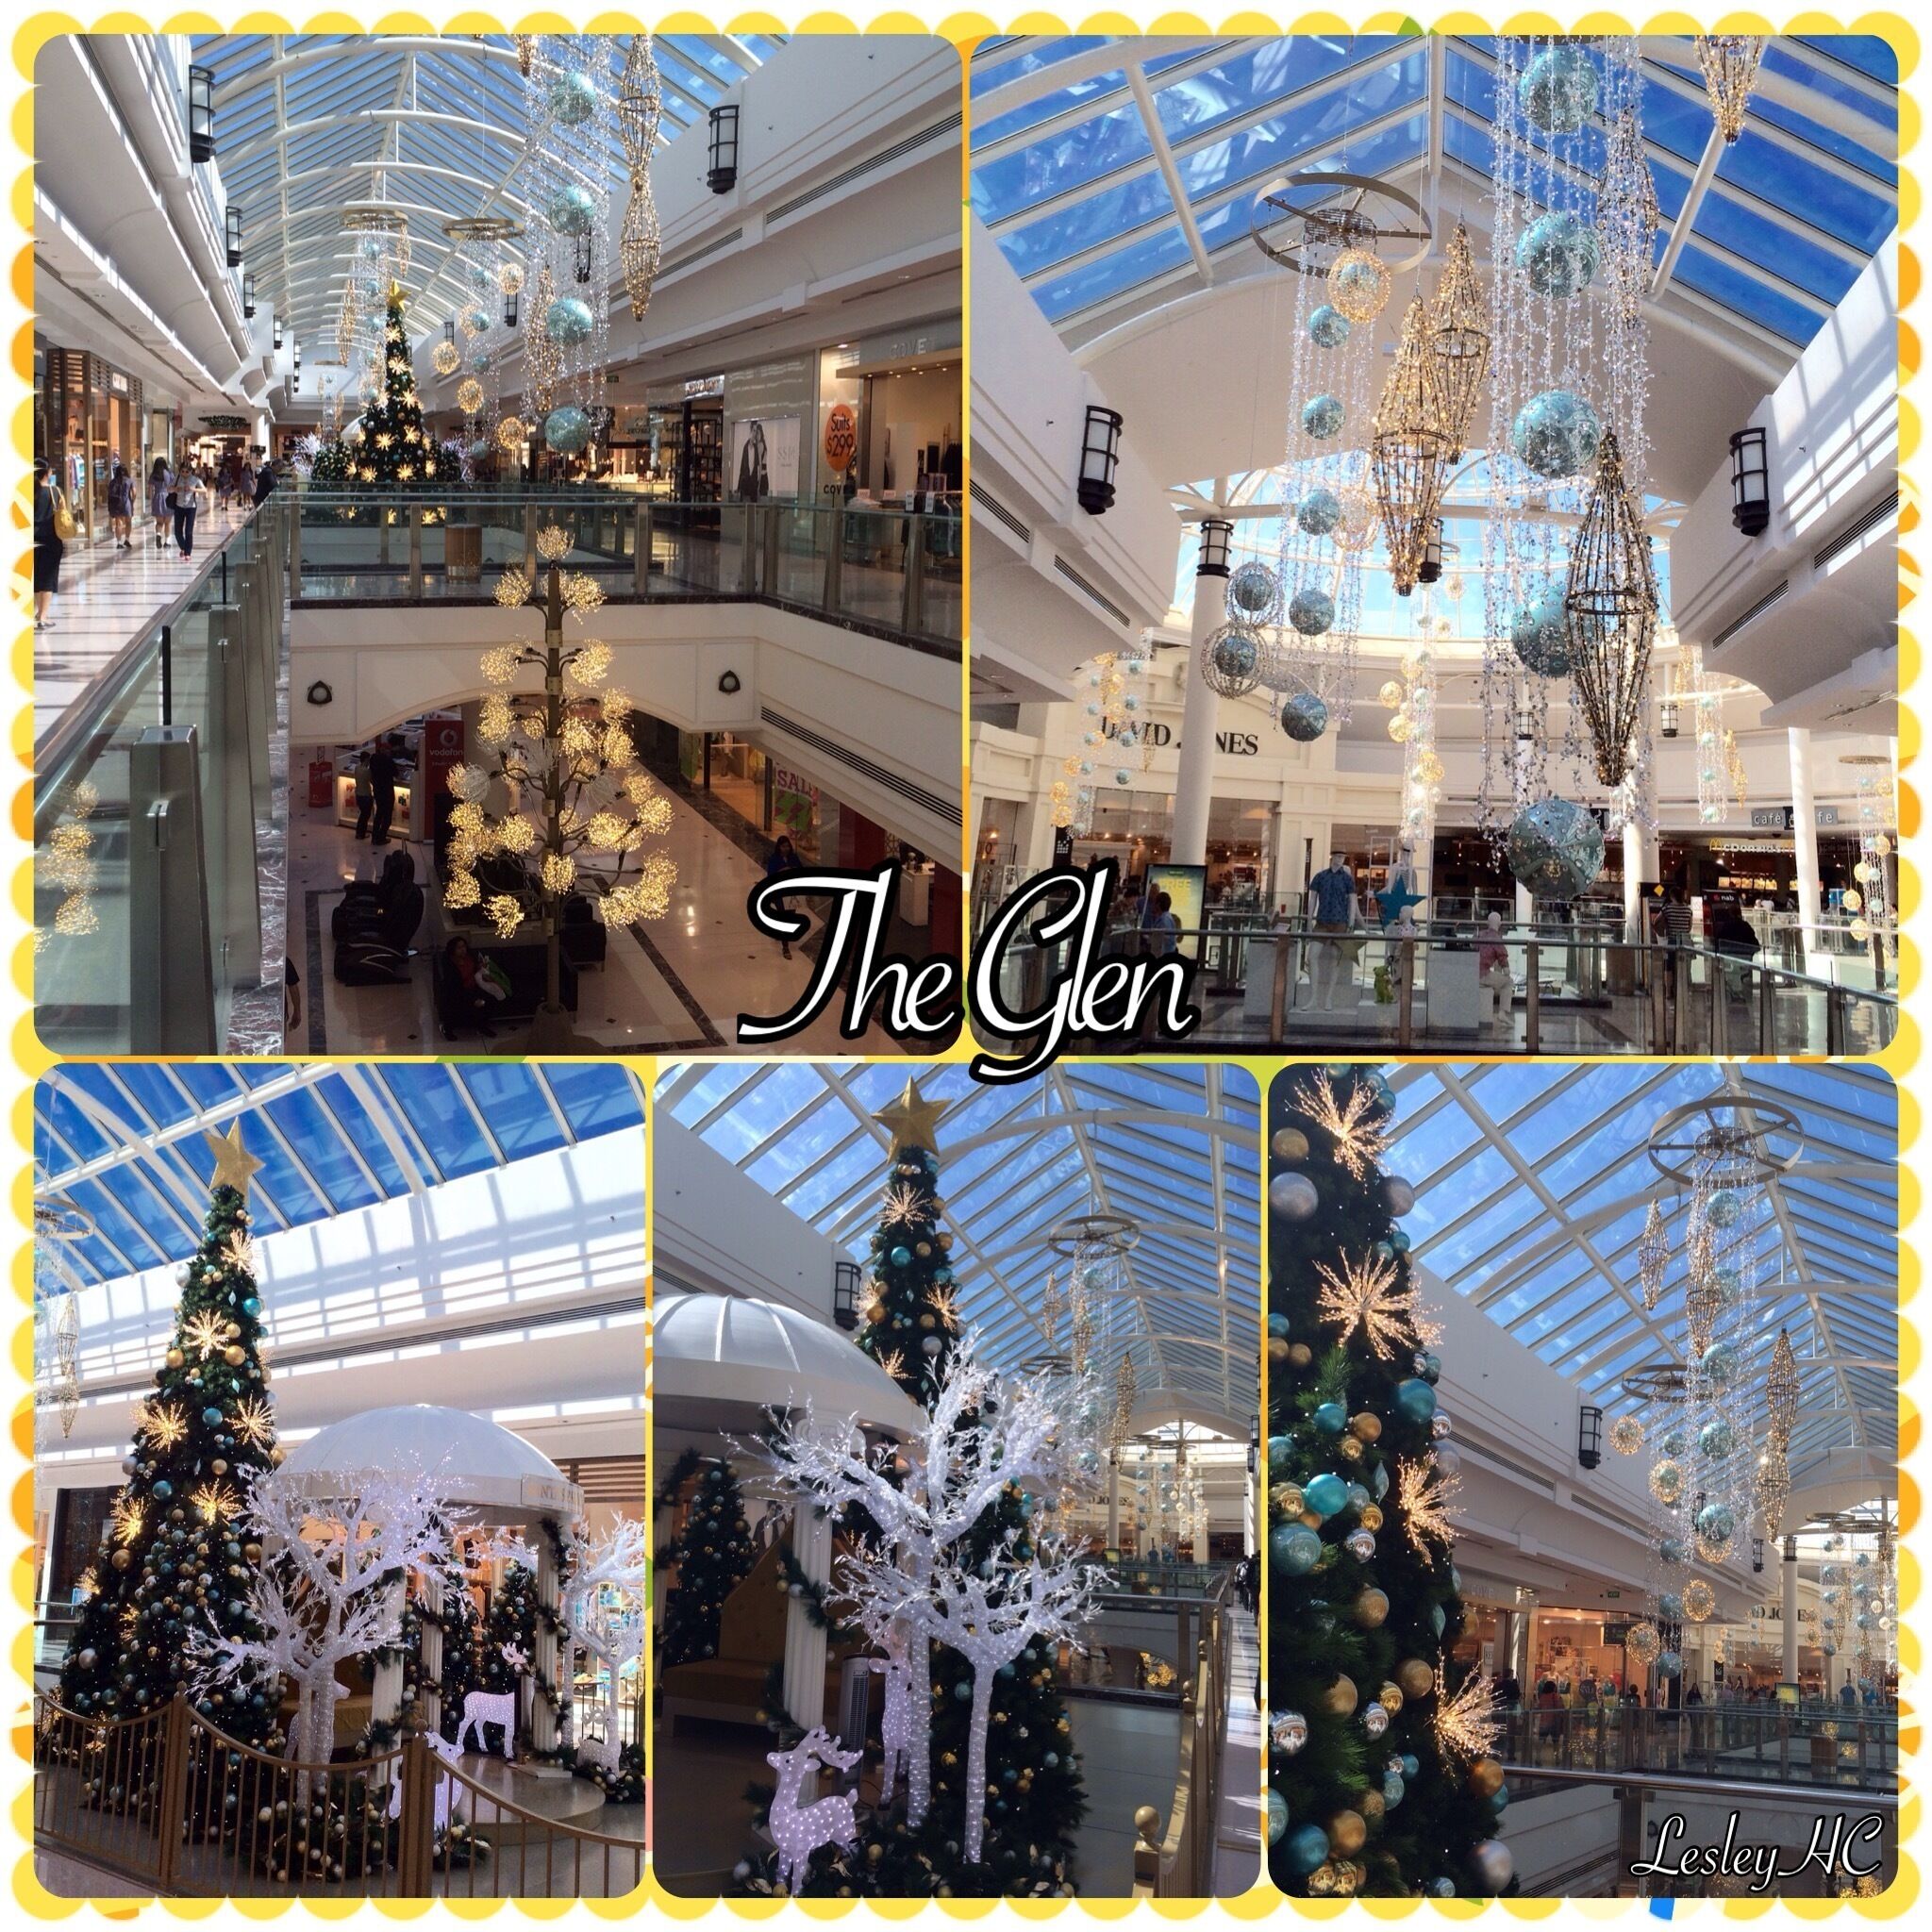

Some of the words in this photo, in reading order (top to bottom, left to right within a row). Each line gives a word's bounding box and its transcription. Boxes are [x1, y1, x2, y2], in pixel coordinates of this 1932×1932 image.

[831, 413, 851, 432] Suits
[827, 434, 854, 458] $299
[824, 484, 846, 495] COV
[1100, 715, 1172, 747] DID
[1176, 731, 1258, 756] NES
[429, 747, 463, 757] vodafon
